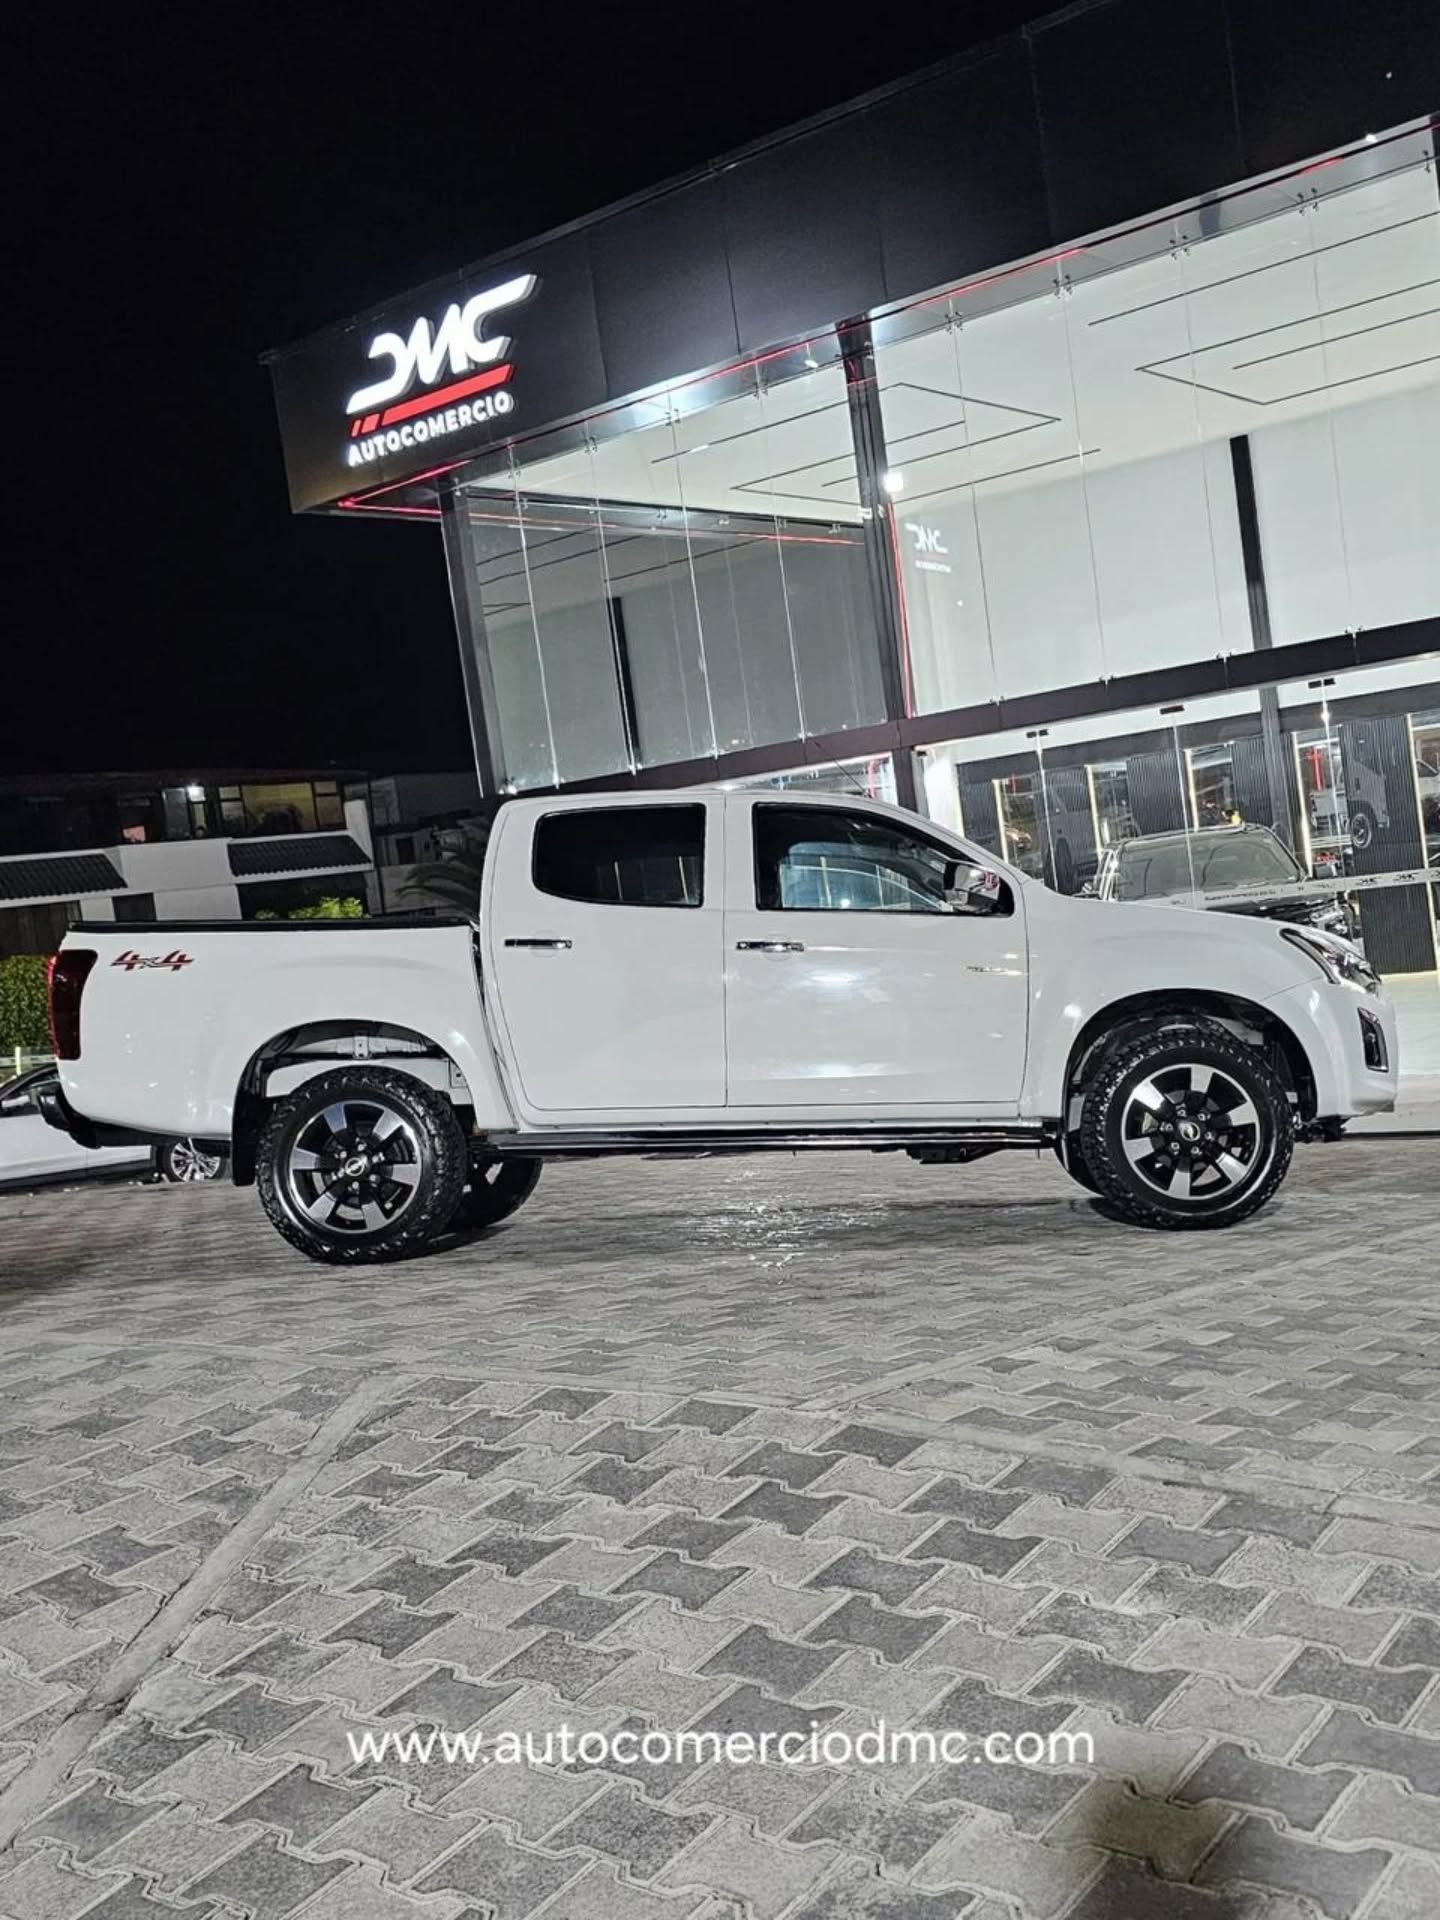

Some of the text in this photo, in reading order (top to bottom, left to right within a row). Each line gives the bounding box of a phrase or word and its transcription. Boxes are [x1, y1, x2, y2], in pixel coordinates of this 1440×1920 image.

[346, 274, 537, 414] DMC
[346, 391, 512, 466] AUTOCOMERCIO
[110, 950, 194, 972] 4x4
